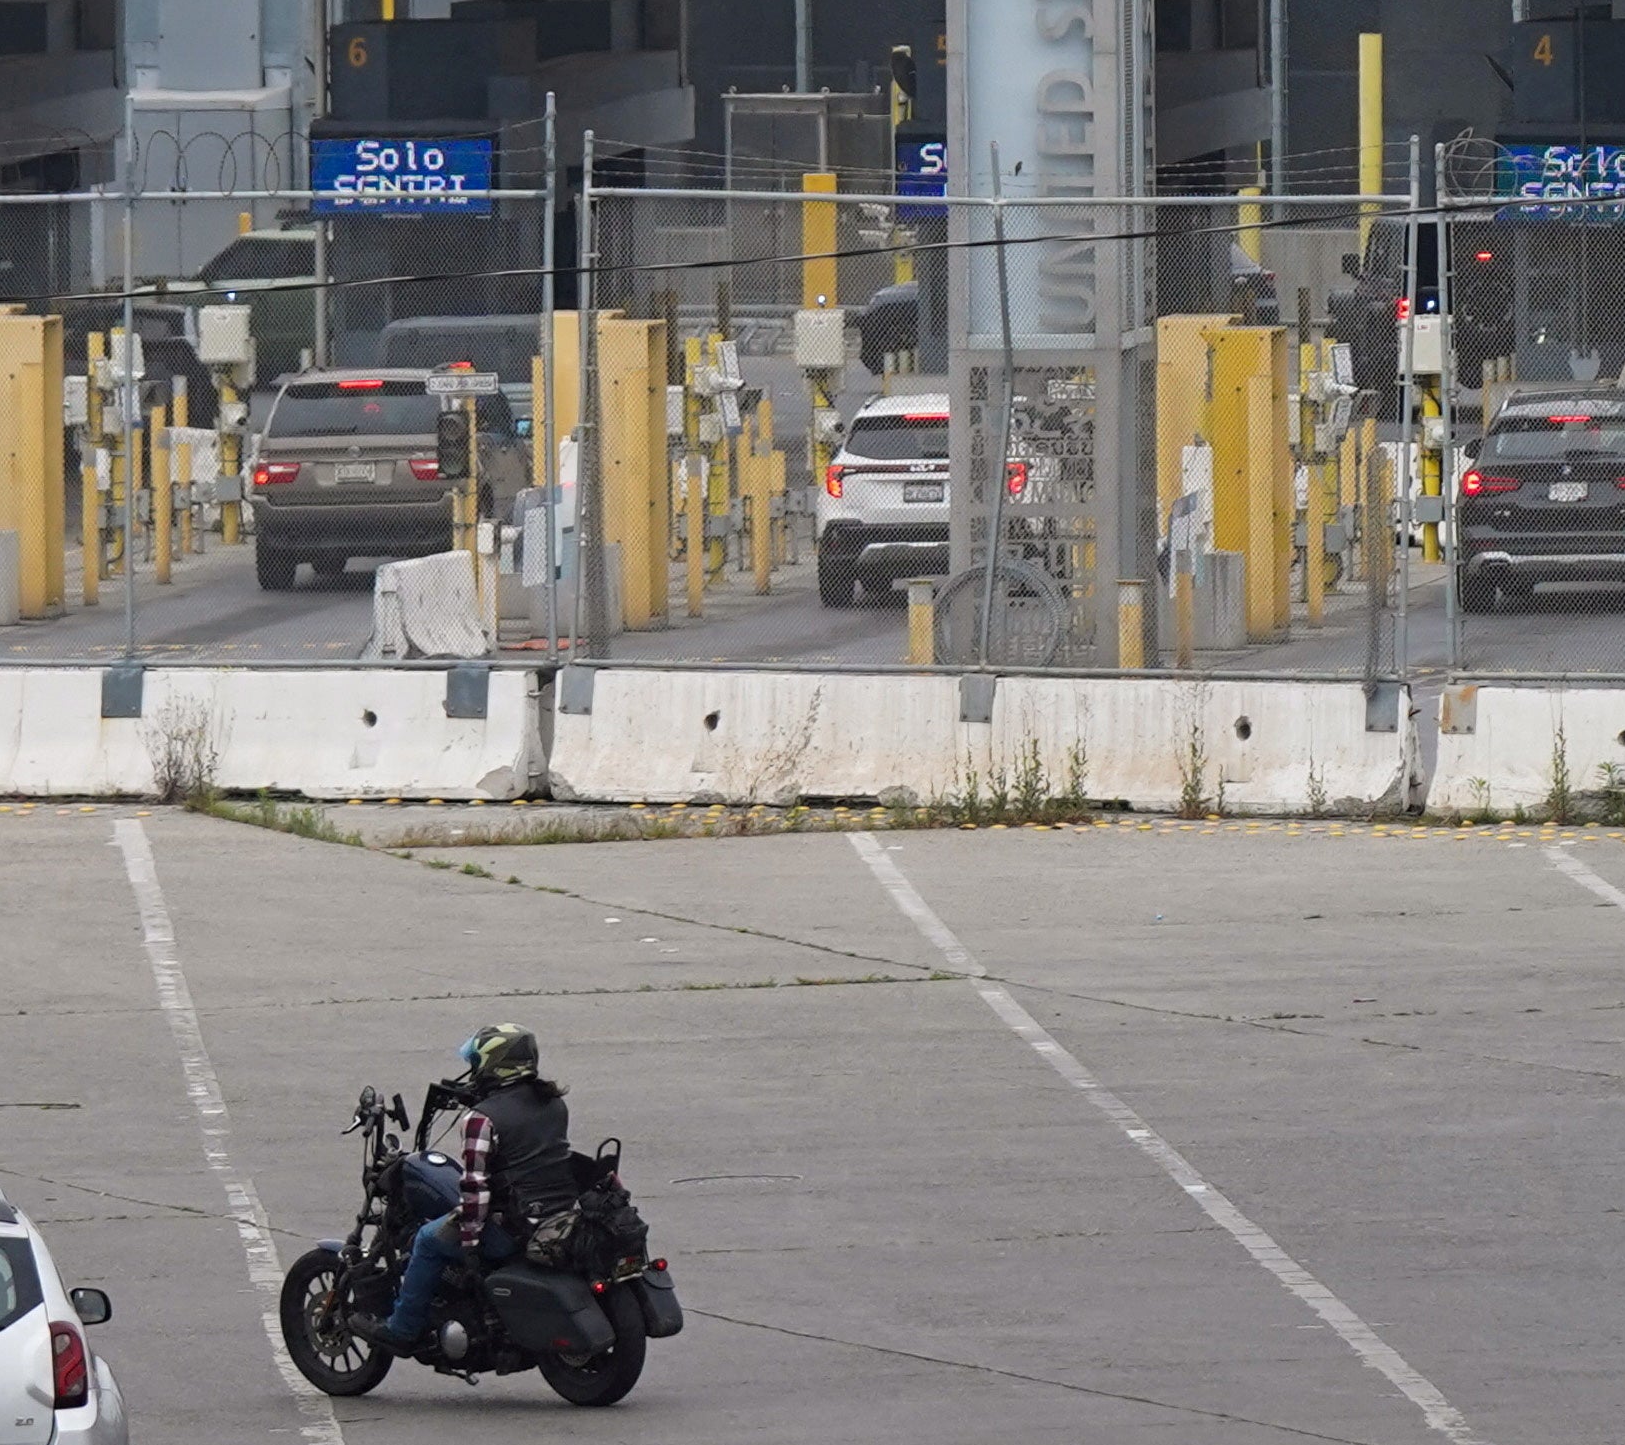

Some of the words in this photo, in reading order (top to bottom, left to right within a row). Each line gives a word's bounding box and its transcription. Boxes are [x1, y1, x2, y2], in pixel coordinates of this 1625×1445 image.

[349, 36, 368, 68] 6
[1533, 34, 1553, 67] 4
[355, 140, 445, 171] Solo
